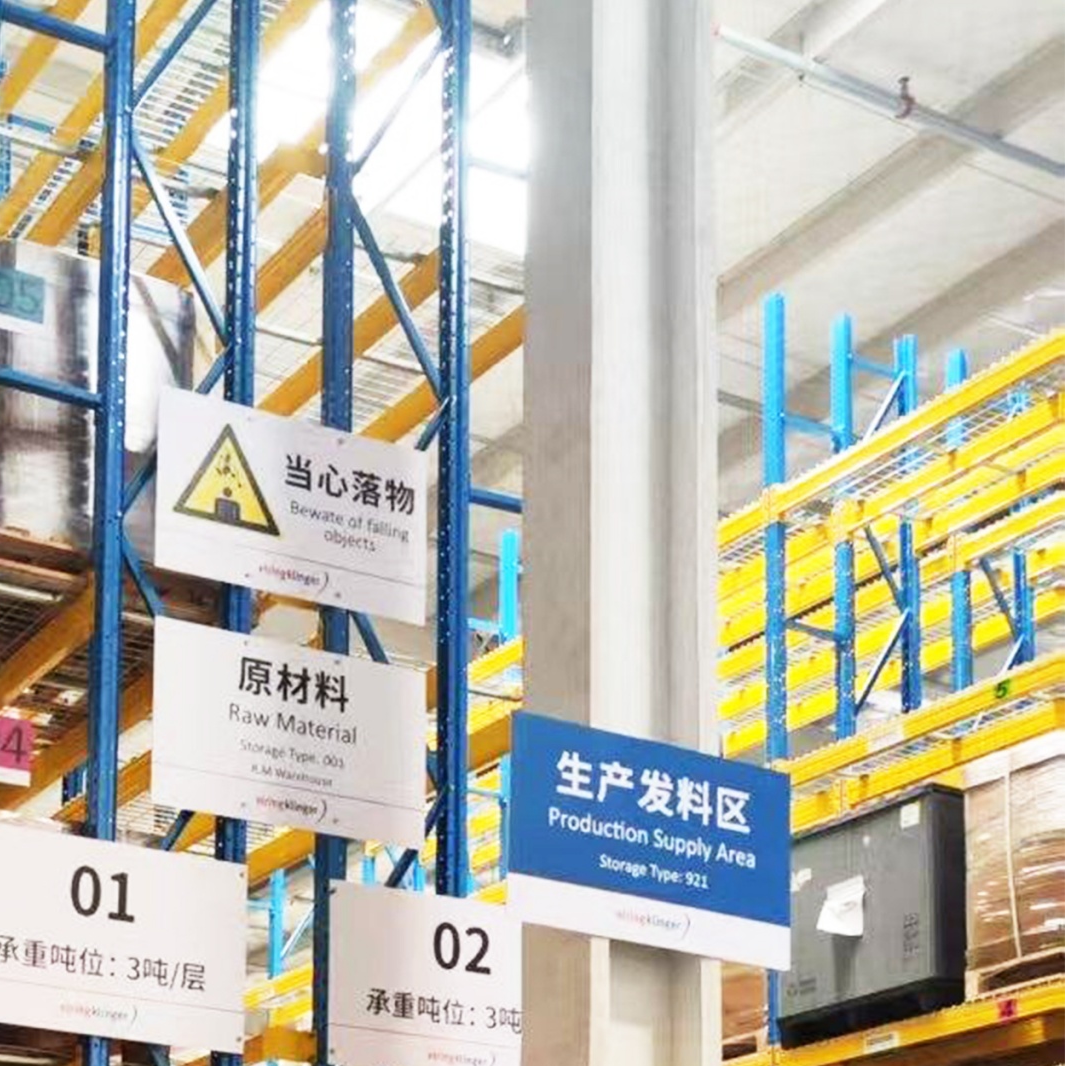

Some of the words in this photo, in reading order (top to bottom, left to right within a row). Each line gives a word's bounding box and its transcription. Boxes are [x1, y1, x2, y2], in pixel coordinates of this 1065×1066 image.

[284, 453, 415, 516] 当心落物
[323, 529, 376, 552] objects
[348, 516, 363, 529] of
[367, 518, 410, 544] falling
[238, 656, 349, 713] 原材料
[228, 702, 270, 727] Raw
[276, 712, 357, 744] Material
[240, 739, 286, 760] Storage
[555, 750, 751, 834] 生产发料区
[548, 806, 649, 845] Production
[653, 828, 712, 862] Supply
[716, 842, 756, 869] Area
[70, 864, 135, 923] 01
[599, 853, 647, 878] Storage
[685, 867, 710, 889] 921
[433, 921, 492, 975] 02
